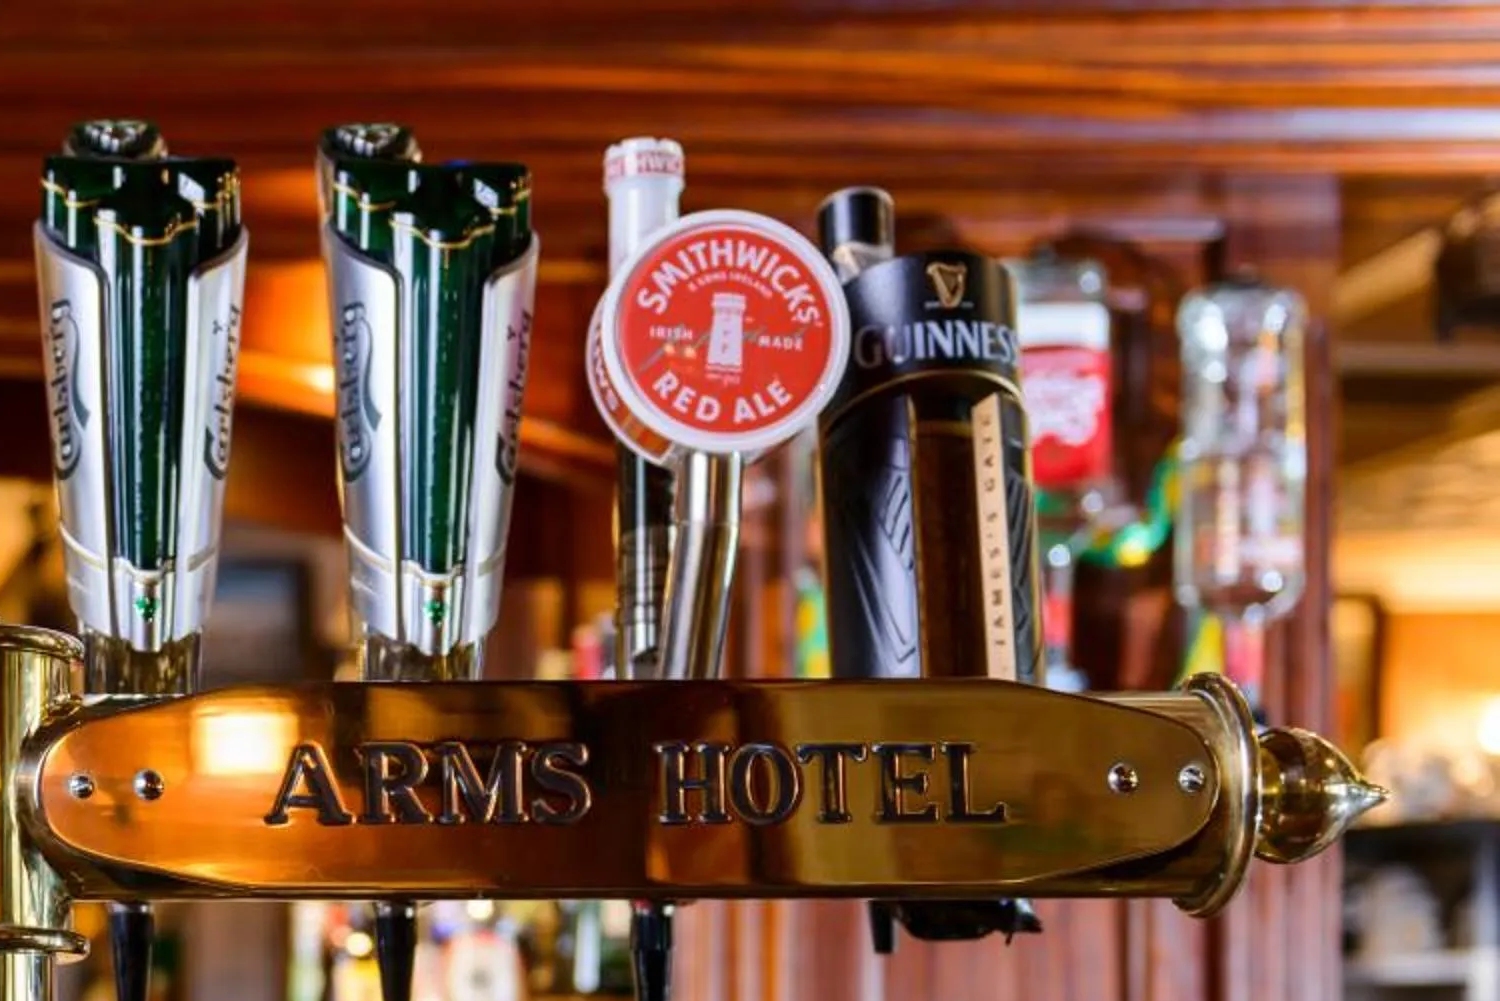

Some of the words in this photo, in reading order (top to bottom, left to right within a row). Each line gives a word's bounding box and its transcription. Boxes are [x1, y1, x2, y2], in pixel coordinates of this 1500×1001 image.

[49, 299, 91, 481] Carlsberg
[652, 370, 721, 422] RED
[733, 379, 794, 425] ALE
[262, 740, 594, 826] ARMS
[653, 742, 1008, 826] HOTEL
